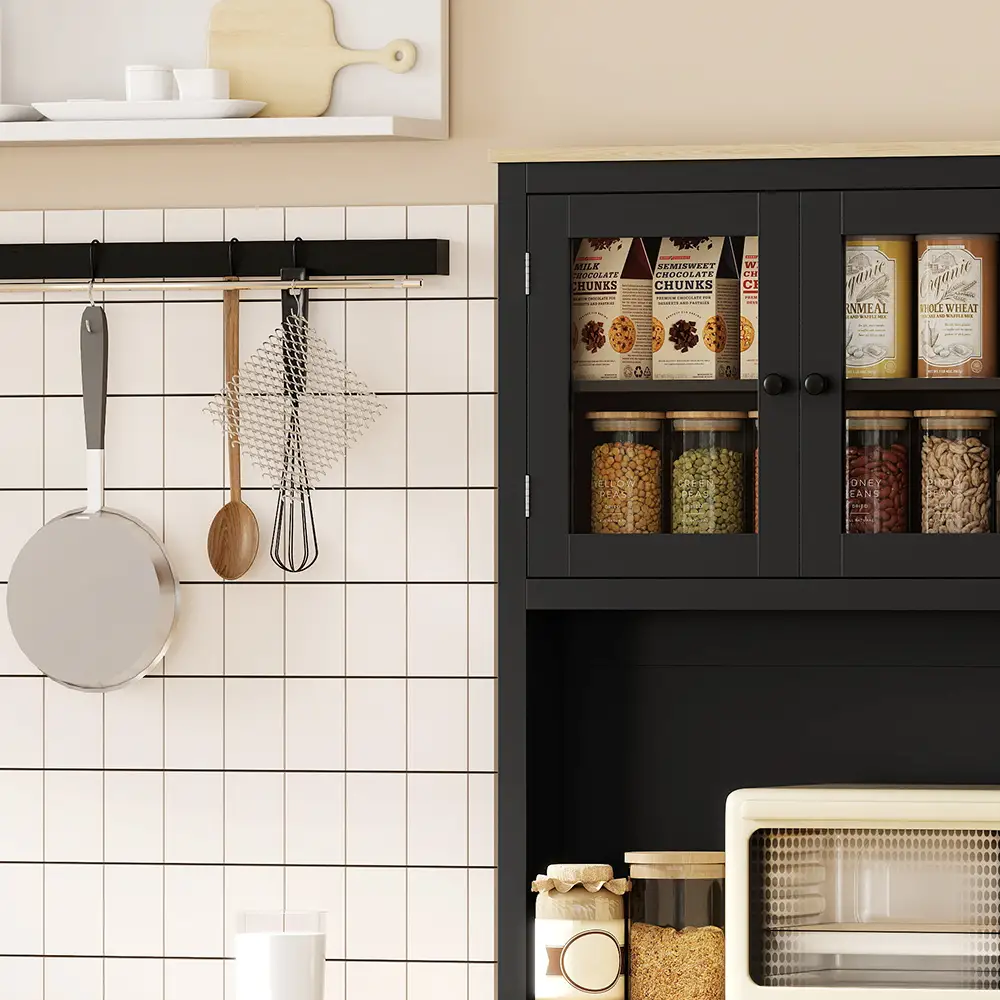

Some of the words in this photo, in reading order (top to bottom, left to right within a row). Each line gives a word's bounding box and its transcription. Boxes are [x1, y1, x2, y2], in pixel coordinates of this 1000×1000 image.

[657, 262, 716, 270] SEMISWEET
[655, 271, 714, 279] CHOCOLATE
[920, 259, 972, 299] Organic
[655, 280, 713, 290] CHUNKS
[846, 302, 888, 314] RNMEAL
[945, 303, 978, 313] WHEAT
[678, 480, 714, 488] GREEN
[599, 490, 628, 499] PEAS
[681, 490, 709, 498] PEAS
[849, 490, 880, 498] EANS
